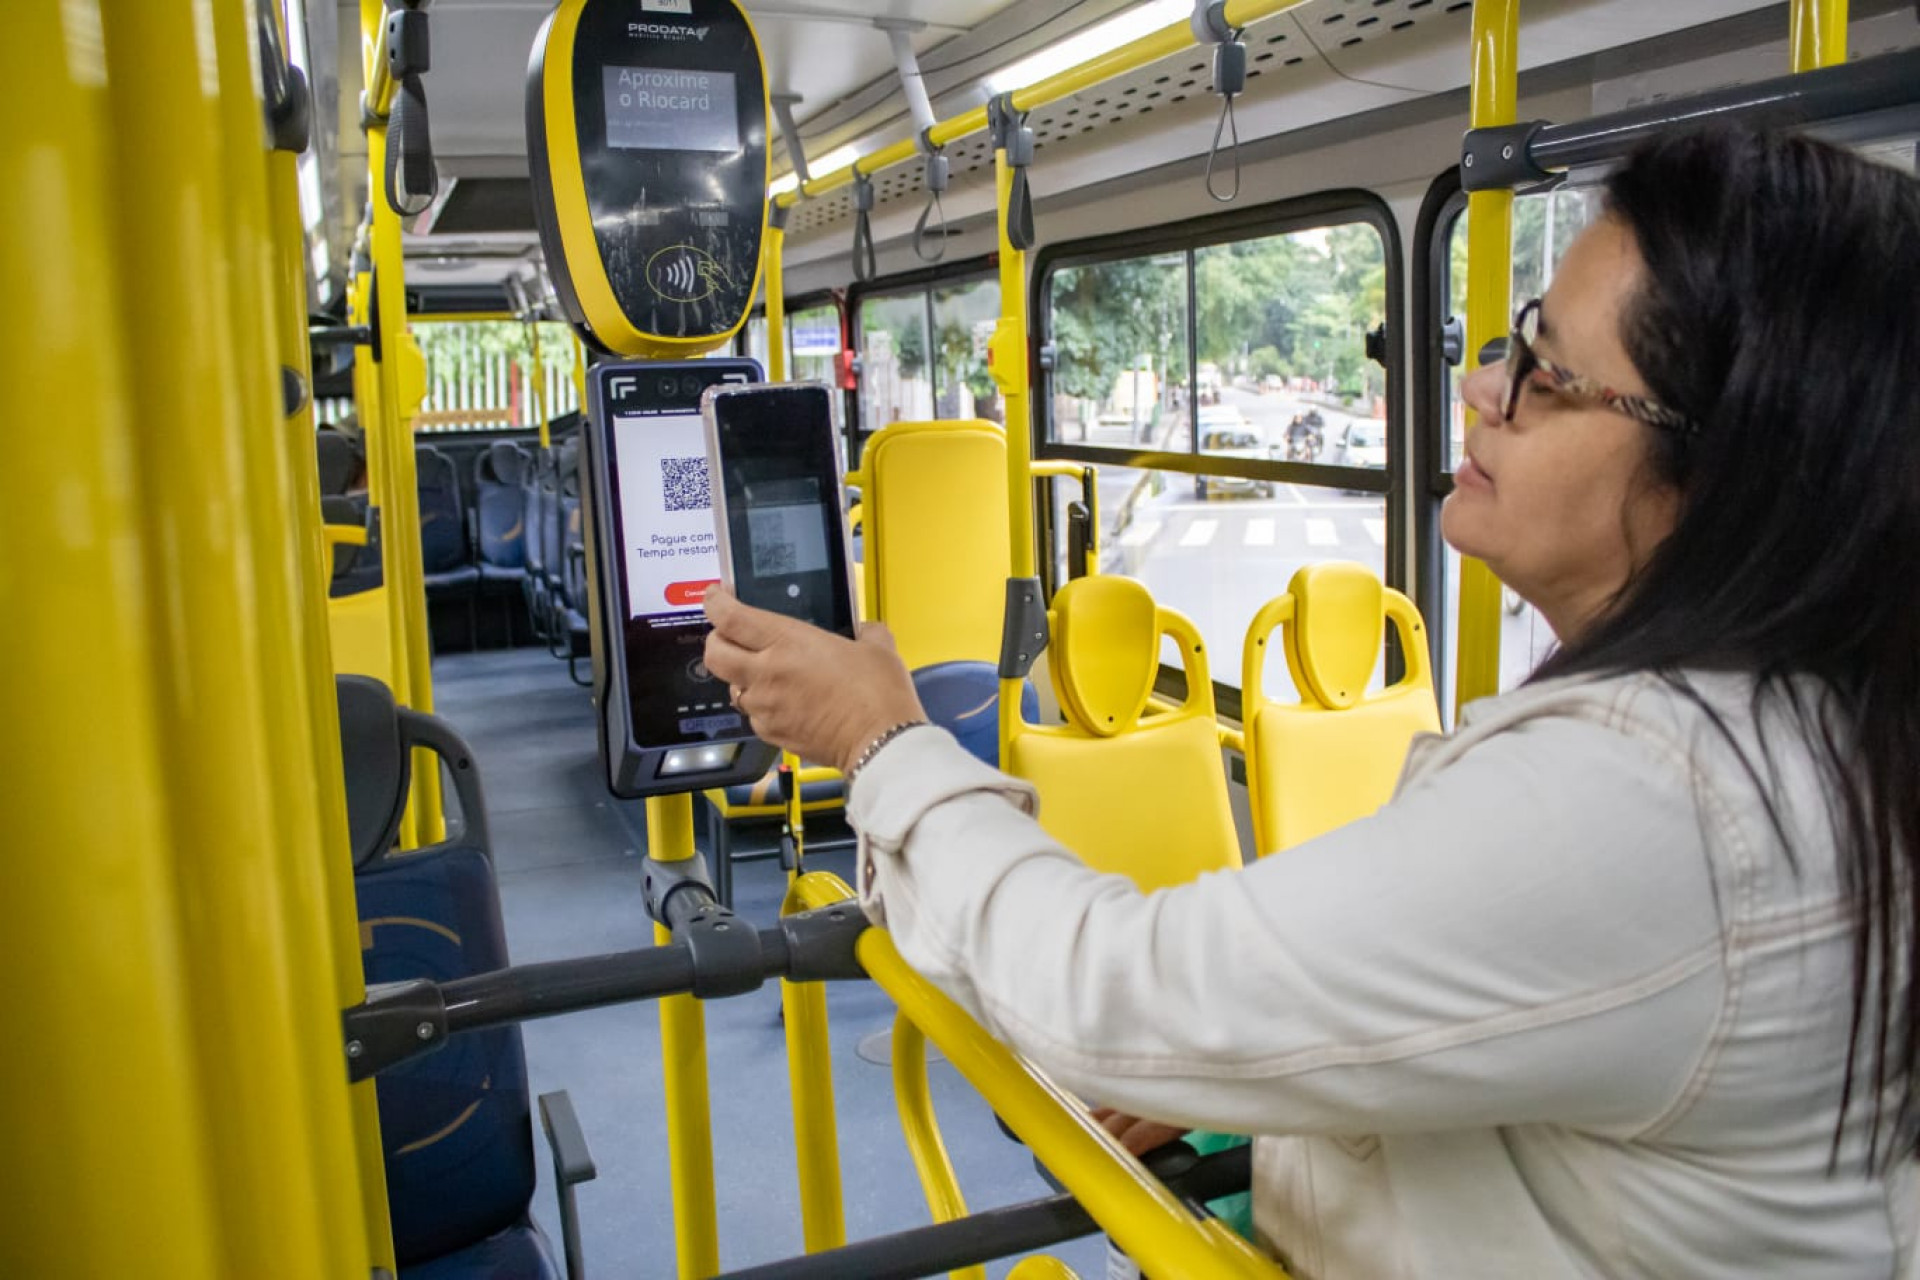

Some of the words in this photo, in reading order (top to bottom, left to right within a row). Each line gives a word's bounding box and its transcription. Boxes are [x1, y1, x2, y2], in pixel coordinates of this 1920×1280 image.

[628, 23, 696, 36] PRODATA
[619, 69, 709, 90] Aproxime
[620, 93, 631, 107] o
[639, 91, 709, 110] Riocard
[651, 533, 687, 546] Pague
[690, 533, 714, 542] com
[637, 547, 675, 559] Tempo
[678, 544, 719, 555] restant
